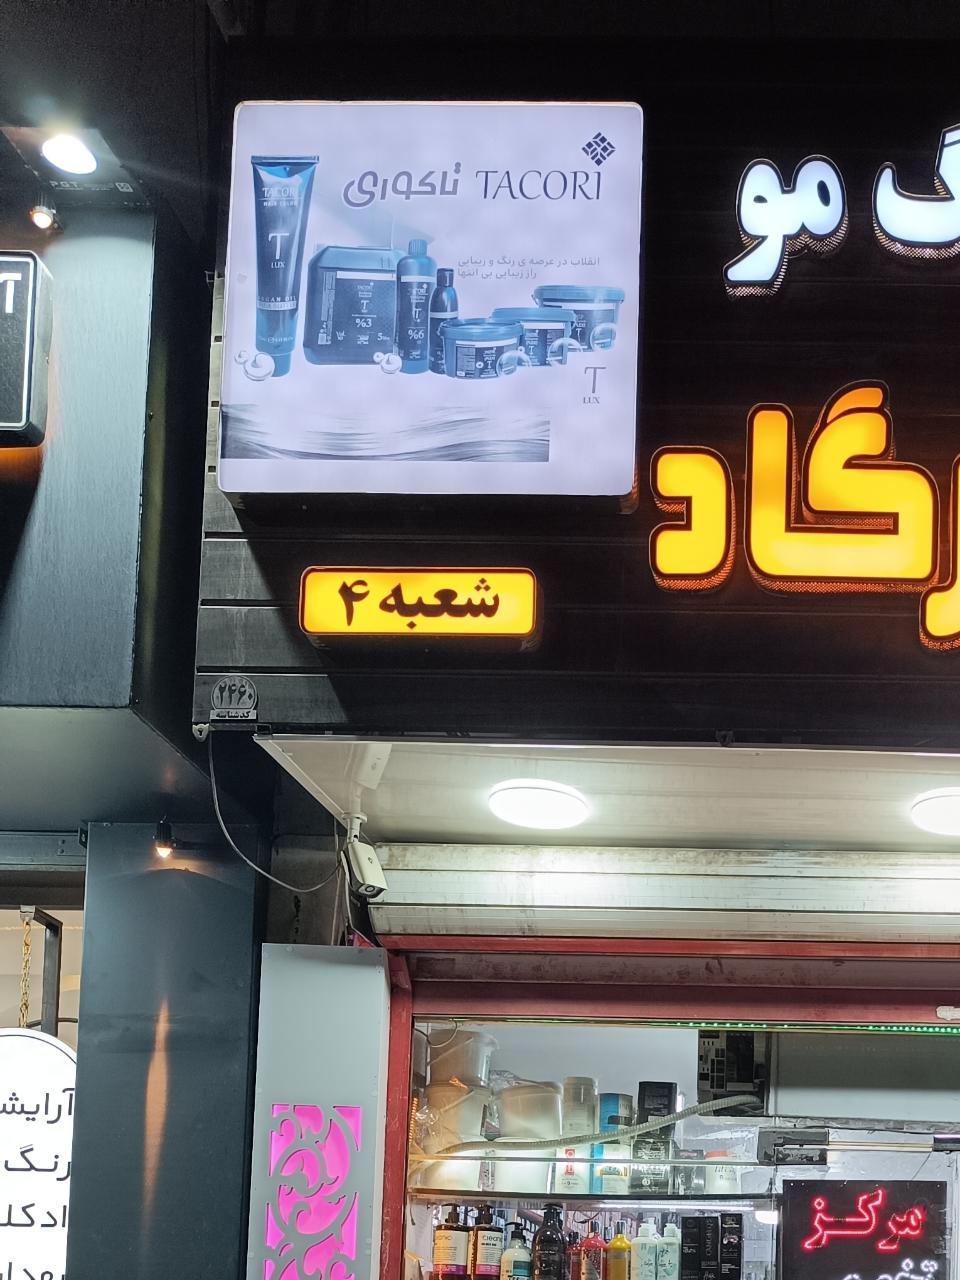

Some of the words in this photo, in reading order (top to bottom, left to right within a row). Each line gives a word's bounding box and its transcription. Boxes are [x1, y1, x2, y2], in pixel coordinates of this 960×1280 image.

[342, 161, 462, 208] تاکوری
[475, 169, 602, 201] TACORI
[723, 155, 848, 283] مو
[582, 396, 600, 405] LUX
[584, 366, 607, 394] T
[337, 579, 370, 627] ۴
[378, 577, 500, 630] شعبه
[4, 1144, 71, 1182] رنگ
[803, 1186, 927, 1251] مرکز
